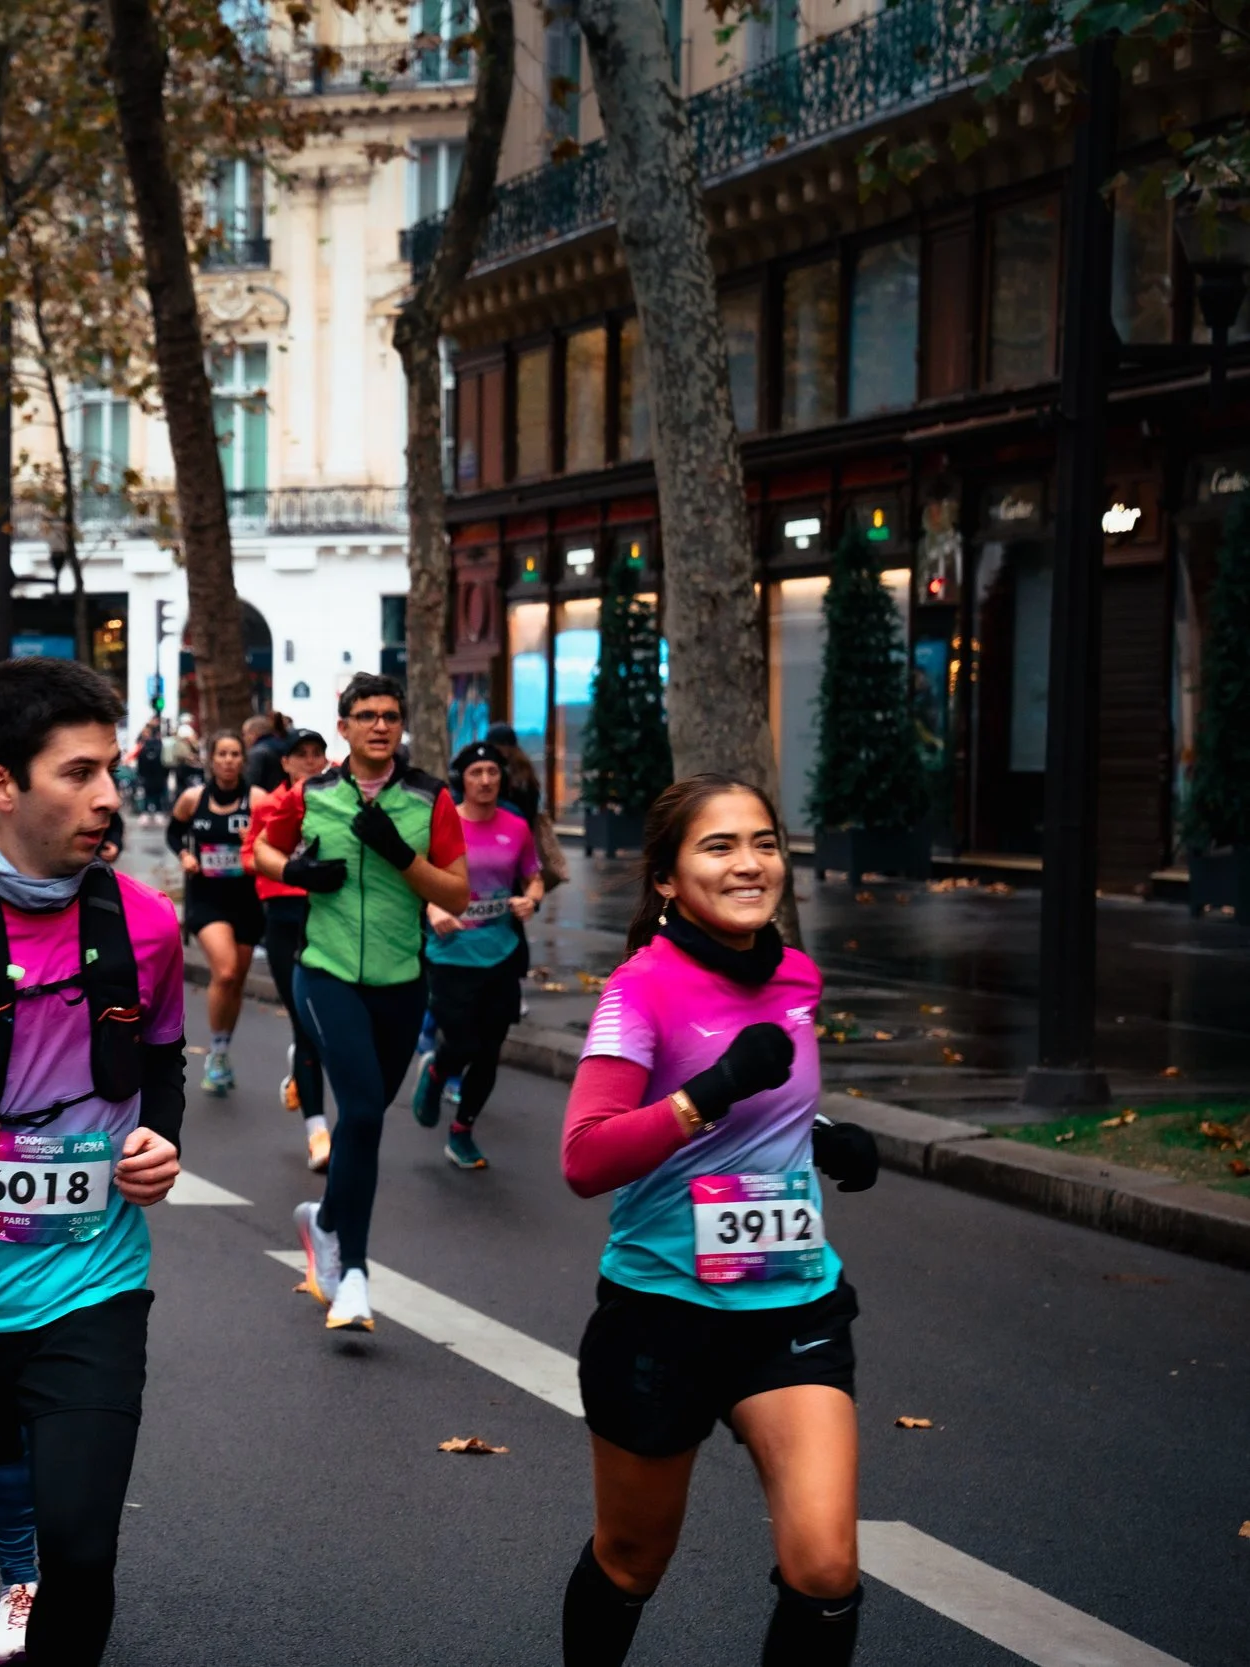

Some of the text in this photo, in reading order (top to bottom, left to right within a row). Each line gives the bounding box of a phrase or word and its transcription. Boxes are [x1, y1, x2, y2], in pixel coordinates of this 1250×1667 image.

[73, 1140, 105, 1154] HOKA
[3, 1216, 30, 1226] PARIS
[716, 1208, 813, 1245] 3912
